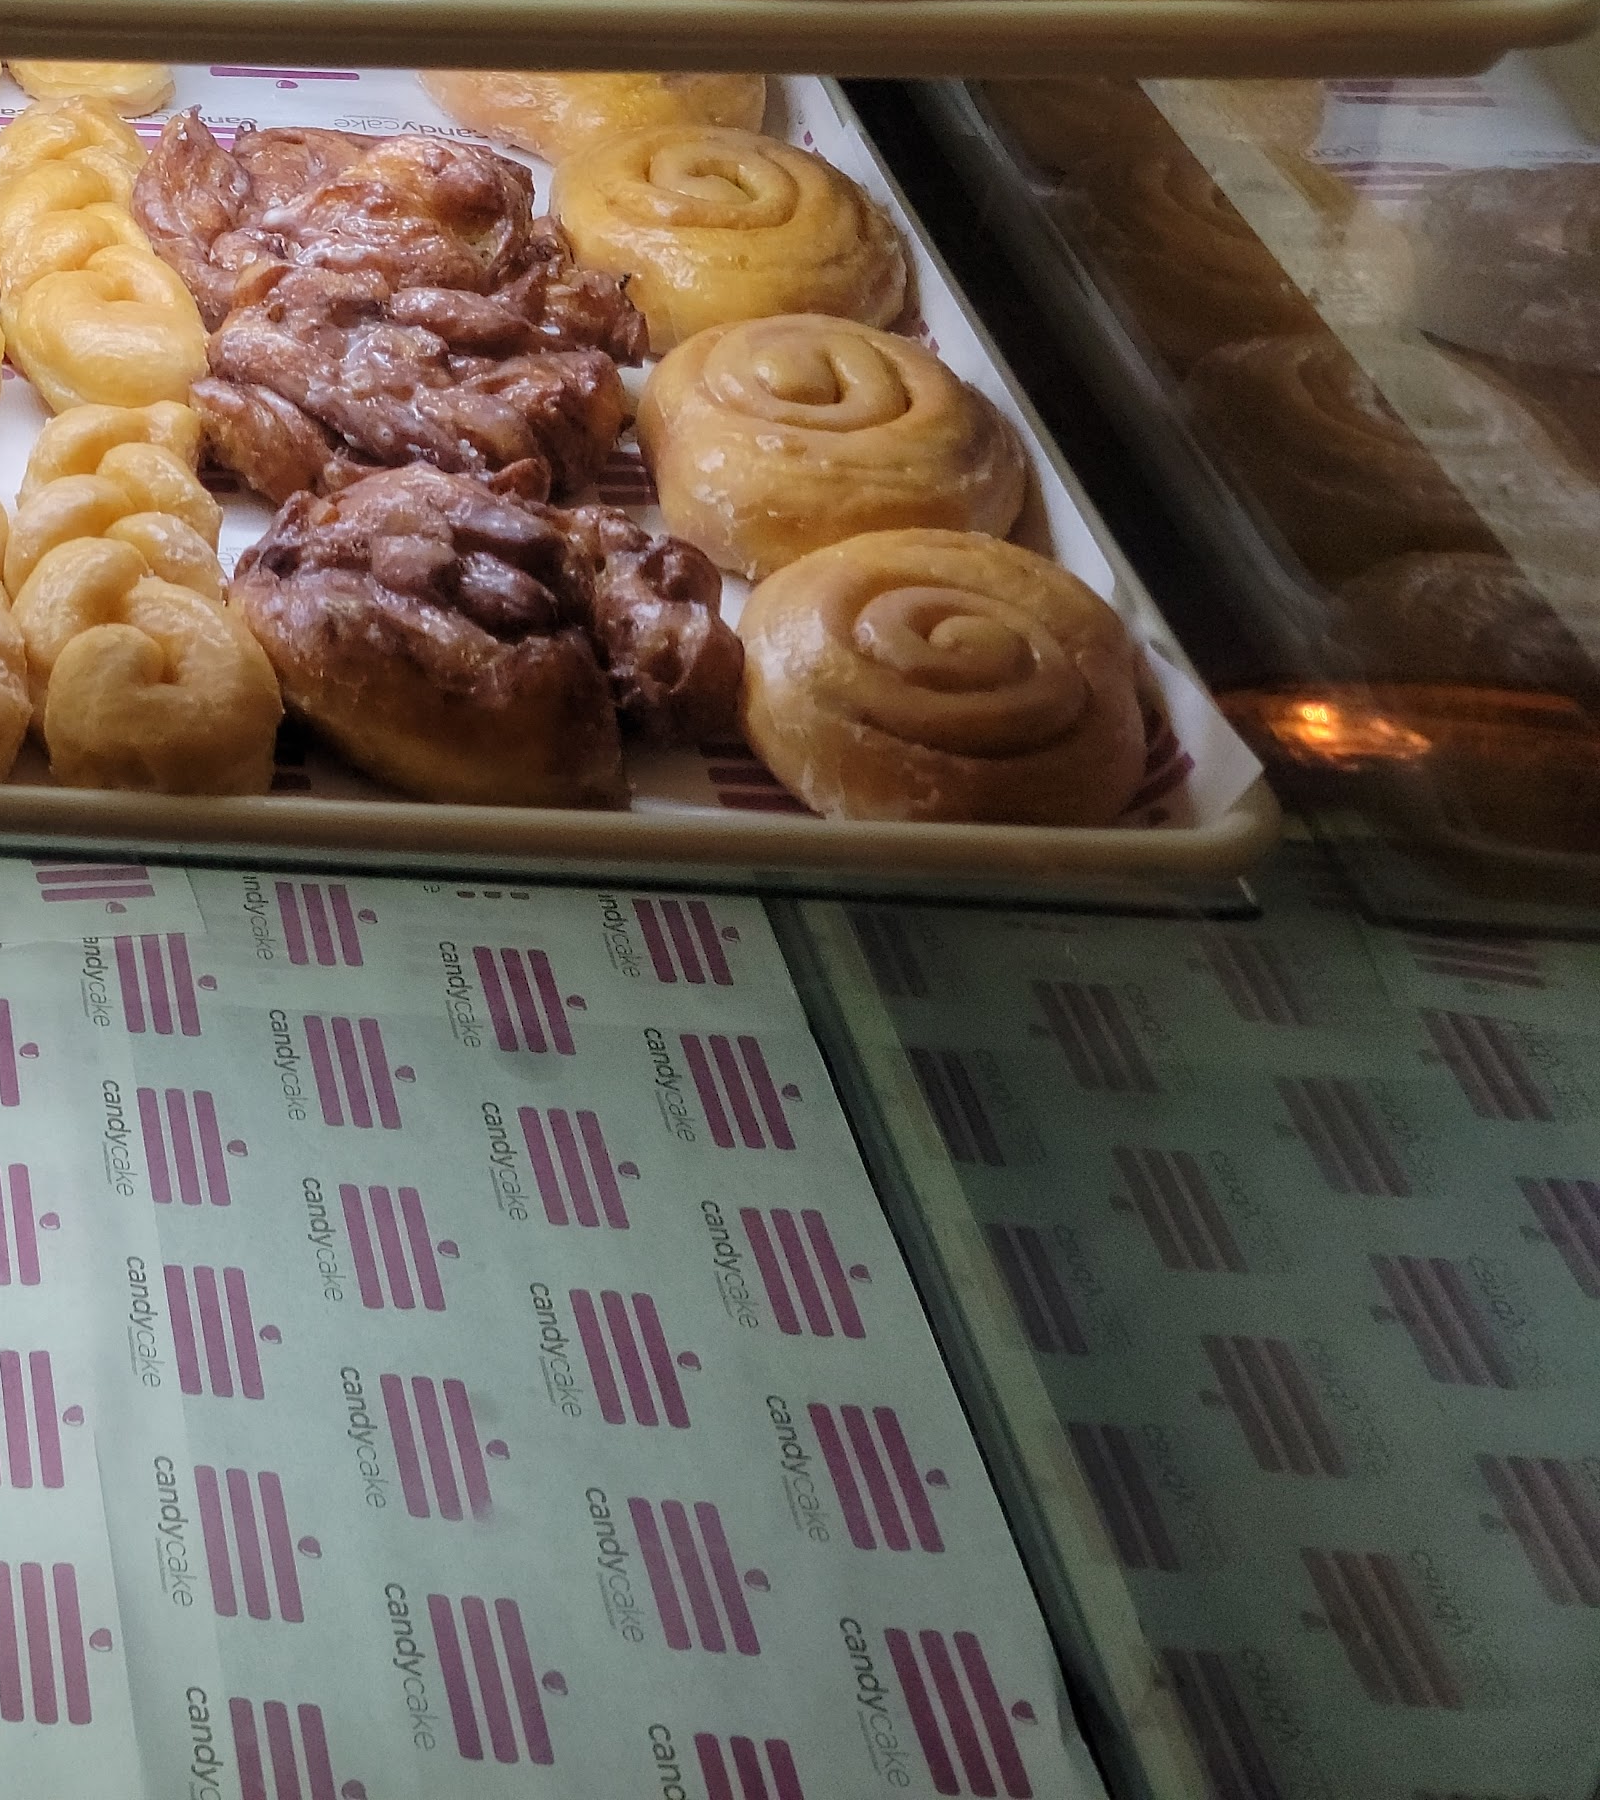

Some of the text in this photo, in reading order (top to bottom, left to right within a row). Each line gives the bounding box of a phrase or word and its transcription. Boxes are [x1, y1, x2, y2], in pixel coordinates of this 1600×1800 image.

[83, 936, 111, 1027] andycake
[439, 941, 482, 1049] candycake
[270, 1009, 307, 1121] candycake
[645, 1027, 697, 1141] candycake
[103, 1079, 134, 1197] candycake
[482, 1102, 528, 1222] candycake
[301, 1177, 344, 1301] candycake
[701, 1200, 759, 1329] candycake
[125, 1256, 162, 1388] candycake
[529, 1282, 581, 1419] candycake
[341, 1367, 387, 1509] candycake
[766, 1394, 830, 1543] candycake
[153, 1456, 194, 1608] candycake
[585, 1486, 644, 1644] candycake
[385, 1583, 436, 1751] candycake
[840, 1617, 910, 1789] candycake
